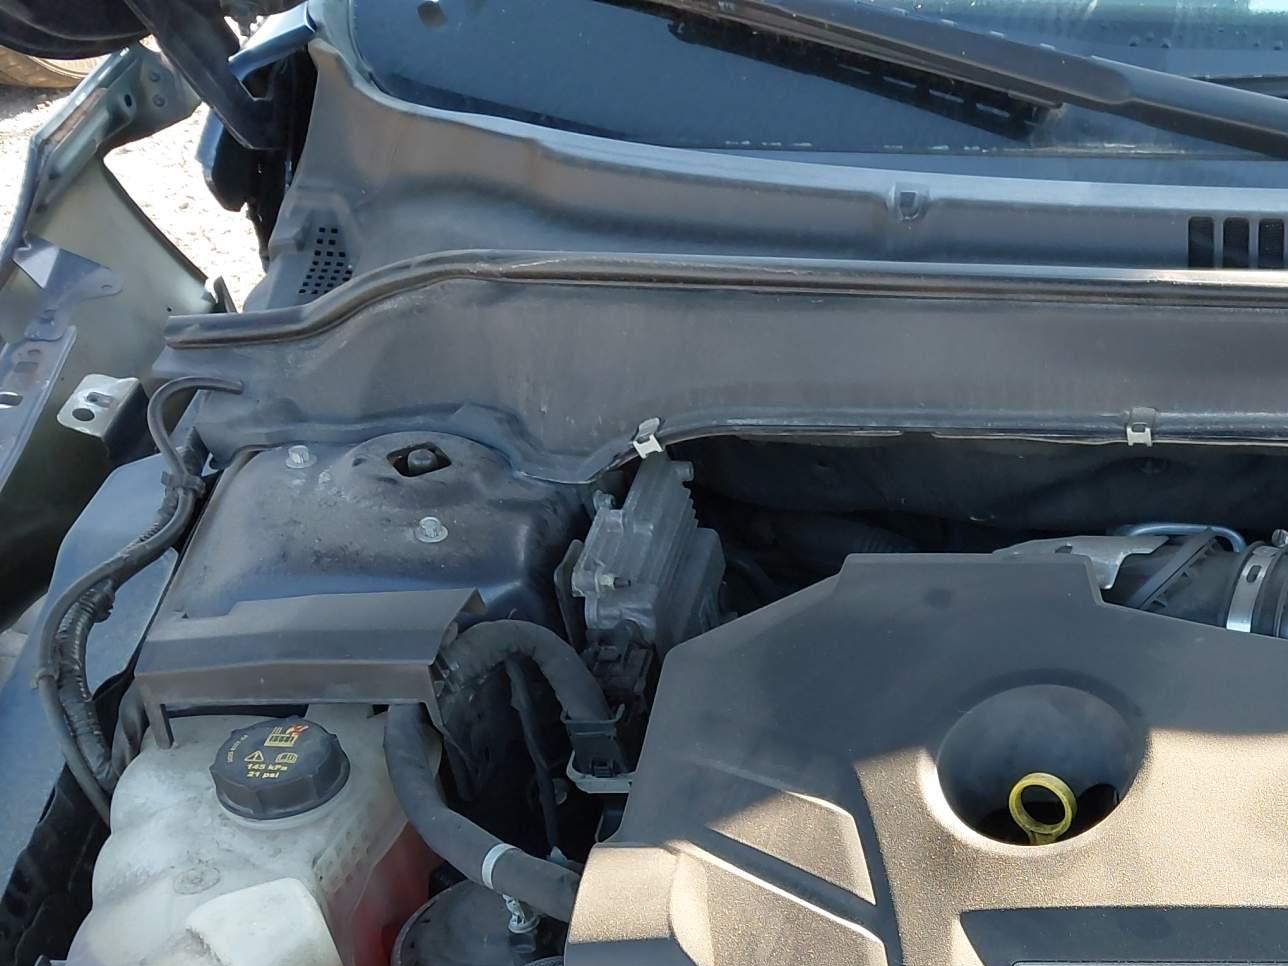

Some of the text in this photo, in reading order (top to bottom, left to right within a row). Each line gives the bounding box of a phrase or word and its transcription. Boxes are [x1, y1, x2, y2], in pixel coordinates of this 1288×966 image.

[247, 763, 288, 771] 145 kPa
[262, 771, 280, 779] psi
